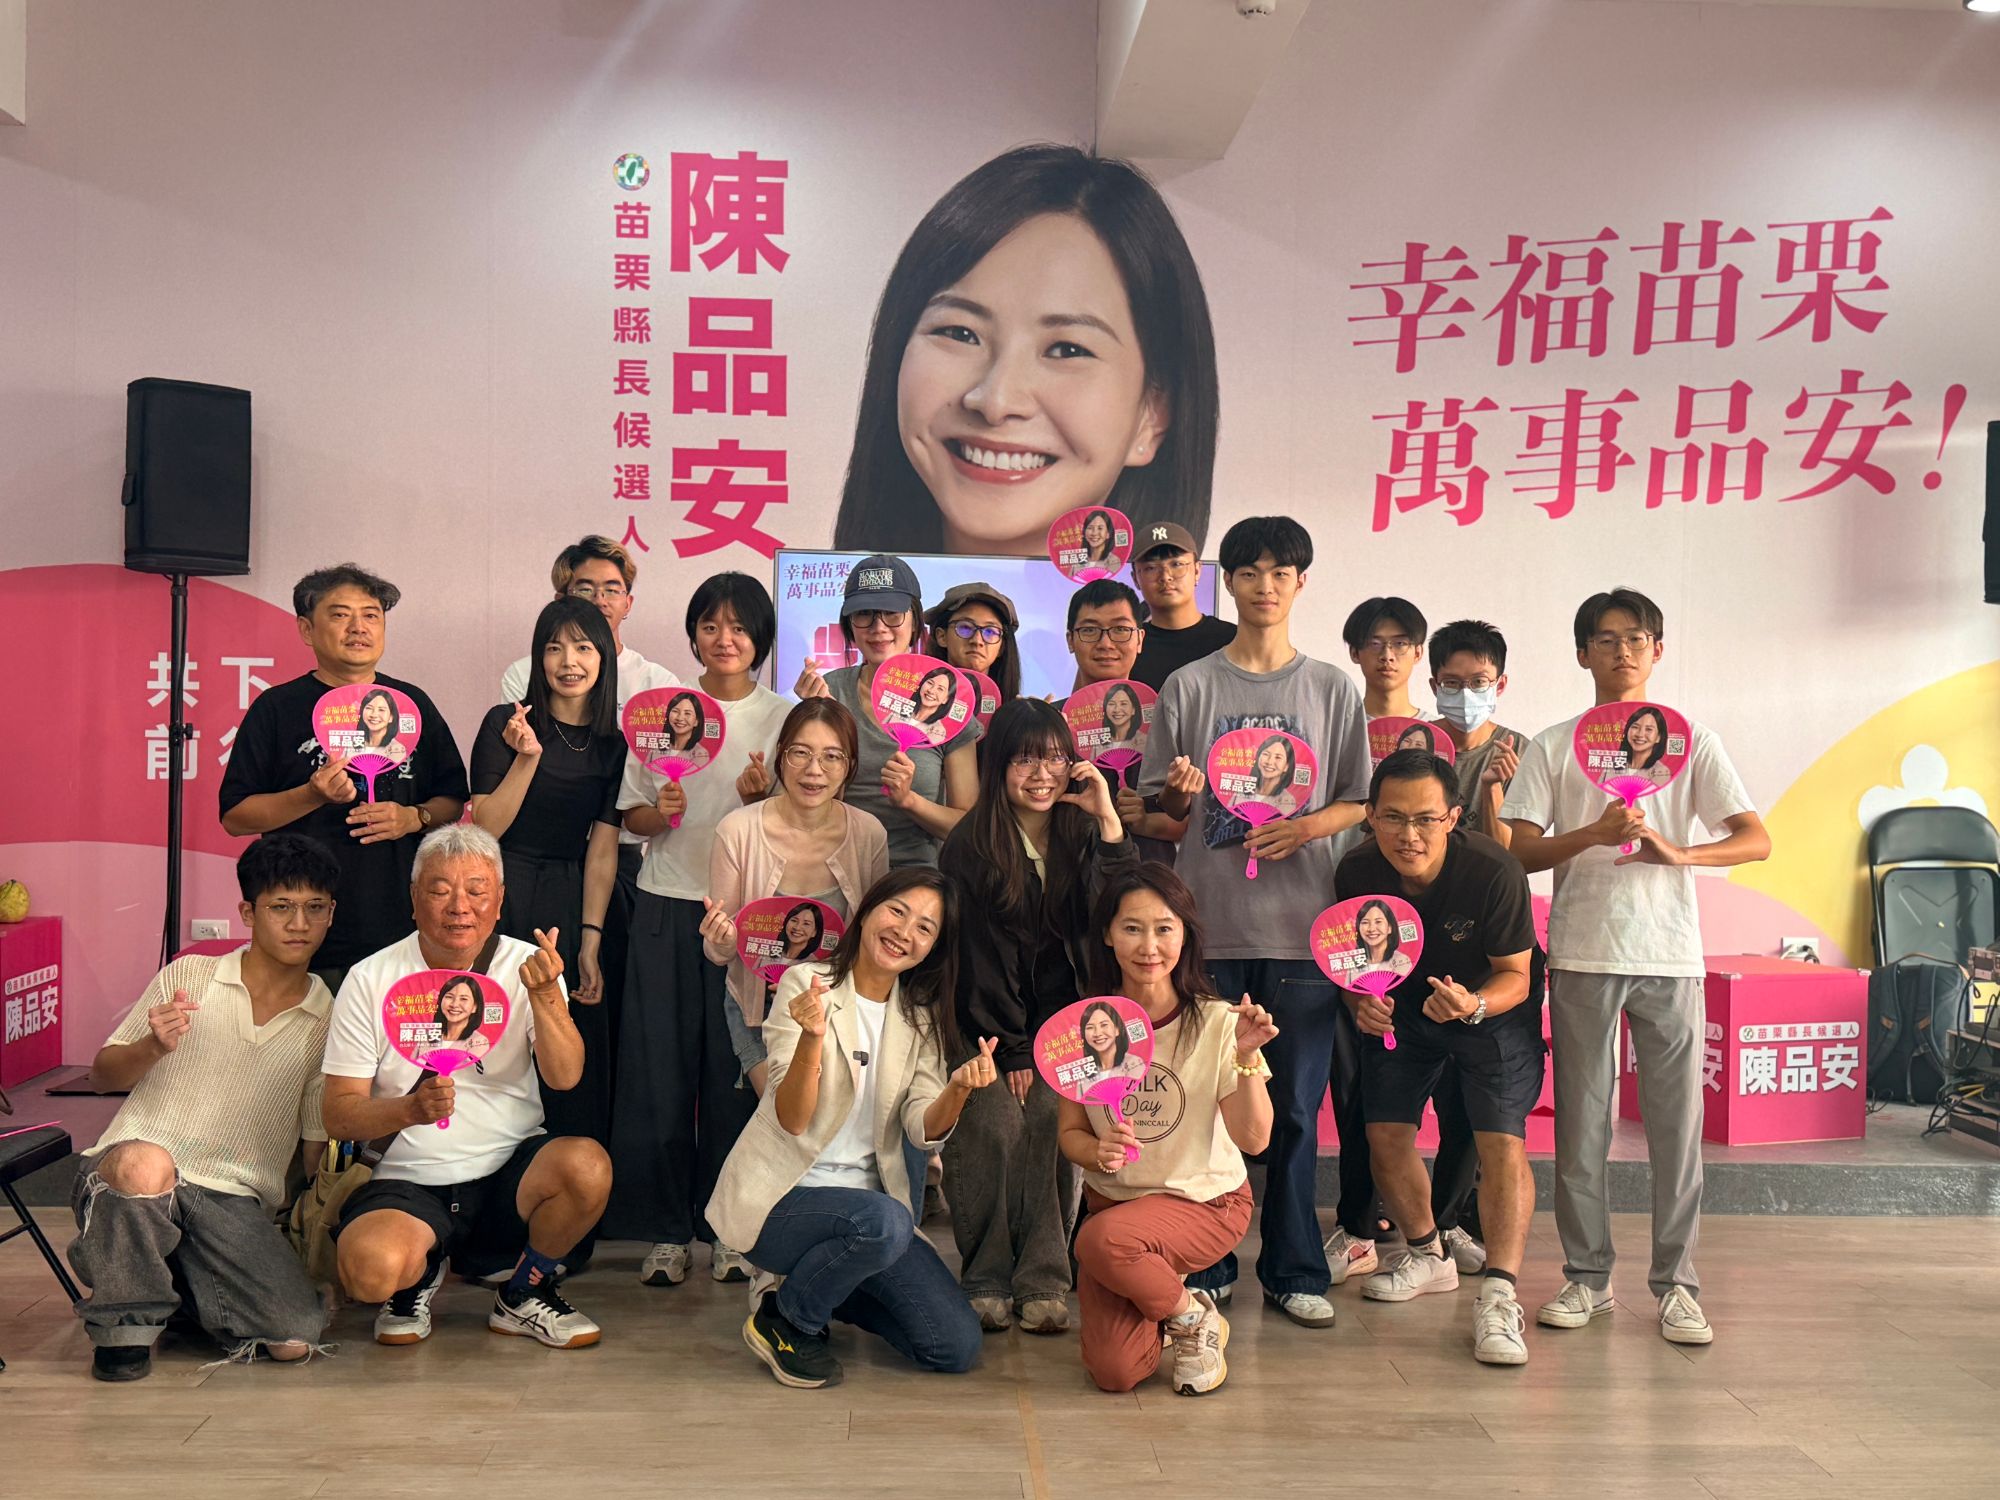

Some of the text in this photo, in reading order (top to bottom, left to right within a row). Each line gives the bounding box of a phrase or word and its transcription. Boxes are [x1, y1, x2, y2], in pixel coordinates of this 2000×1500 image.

[1348, 206, 1894, 373] 幸福苗栗
[670, 151, 791, 560] 陳品安
[613, 201, 651, 553] 苗栗縣長候選人
[1371, 369, 1967, 532] 萬事品安!
[784, 561, 850, 581] 幸福苗栗
[147, 652, 274, 709] 共下
[879, 695, 914, 718] 陳品安
[328, 735, 365, 748] 陳品安
[636, 736, 670, 749] 陳品安
[1078, 732, 1111, 748] 陳品安
[145, 723, 238, 781] 前
[1588, 755, 1627, 769] 陳品安
[1220, 778, 1256, 794] 陳品安
[745, 941, 783, 957] 陳品安
[1329, 954, 1367, 972] 陳品安
[5, 985, 58, 1044] 陳品安
[400, 1028, 442, 1042] 陳品安
[1757, 1024, 1857, 1040] 苗栗縣長候選人
[1057, 1062, 1099, 1086] 陳品安
[1739, 1043, 1859, 1096] 陳品安
[1121, 1094, 1162, 1117] Day
